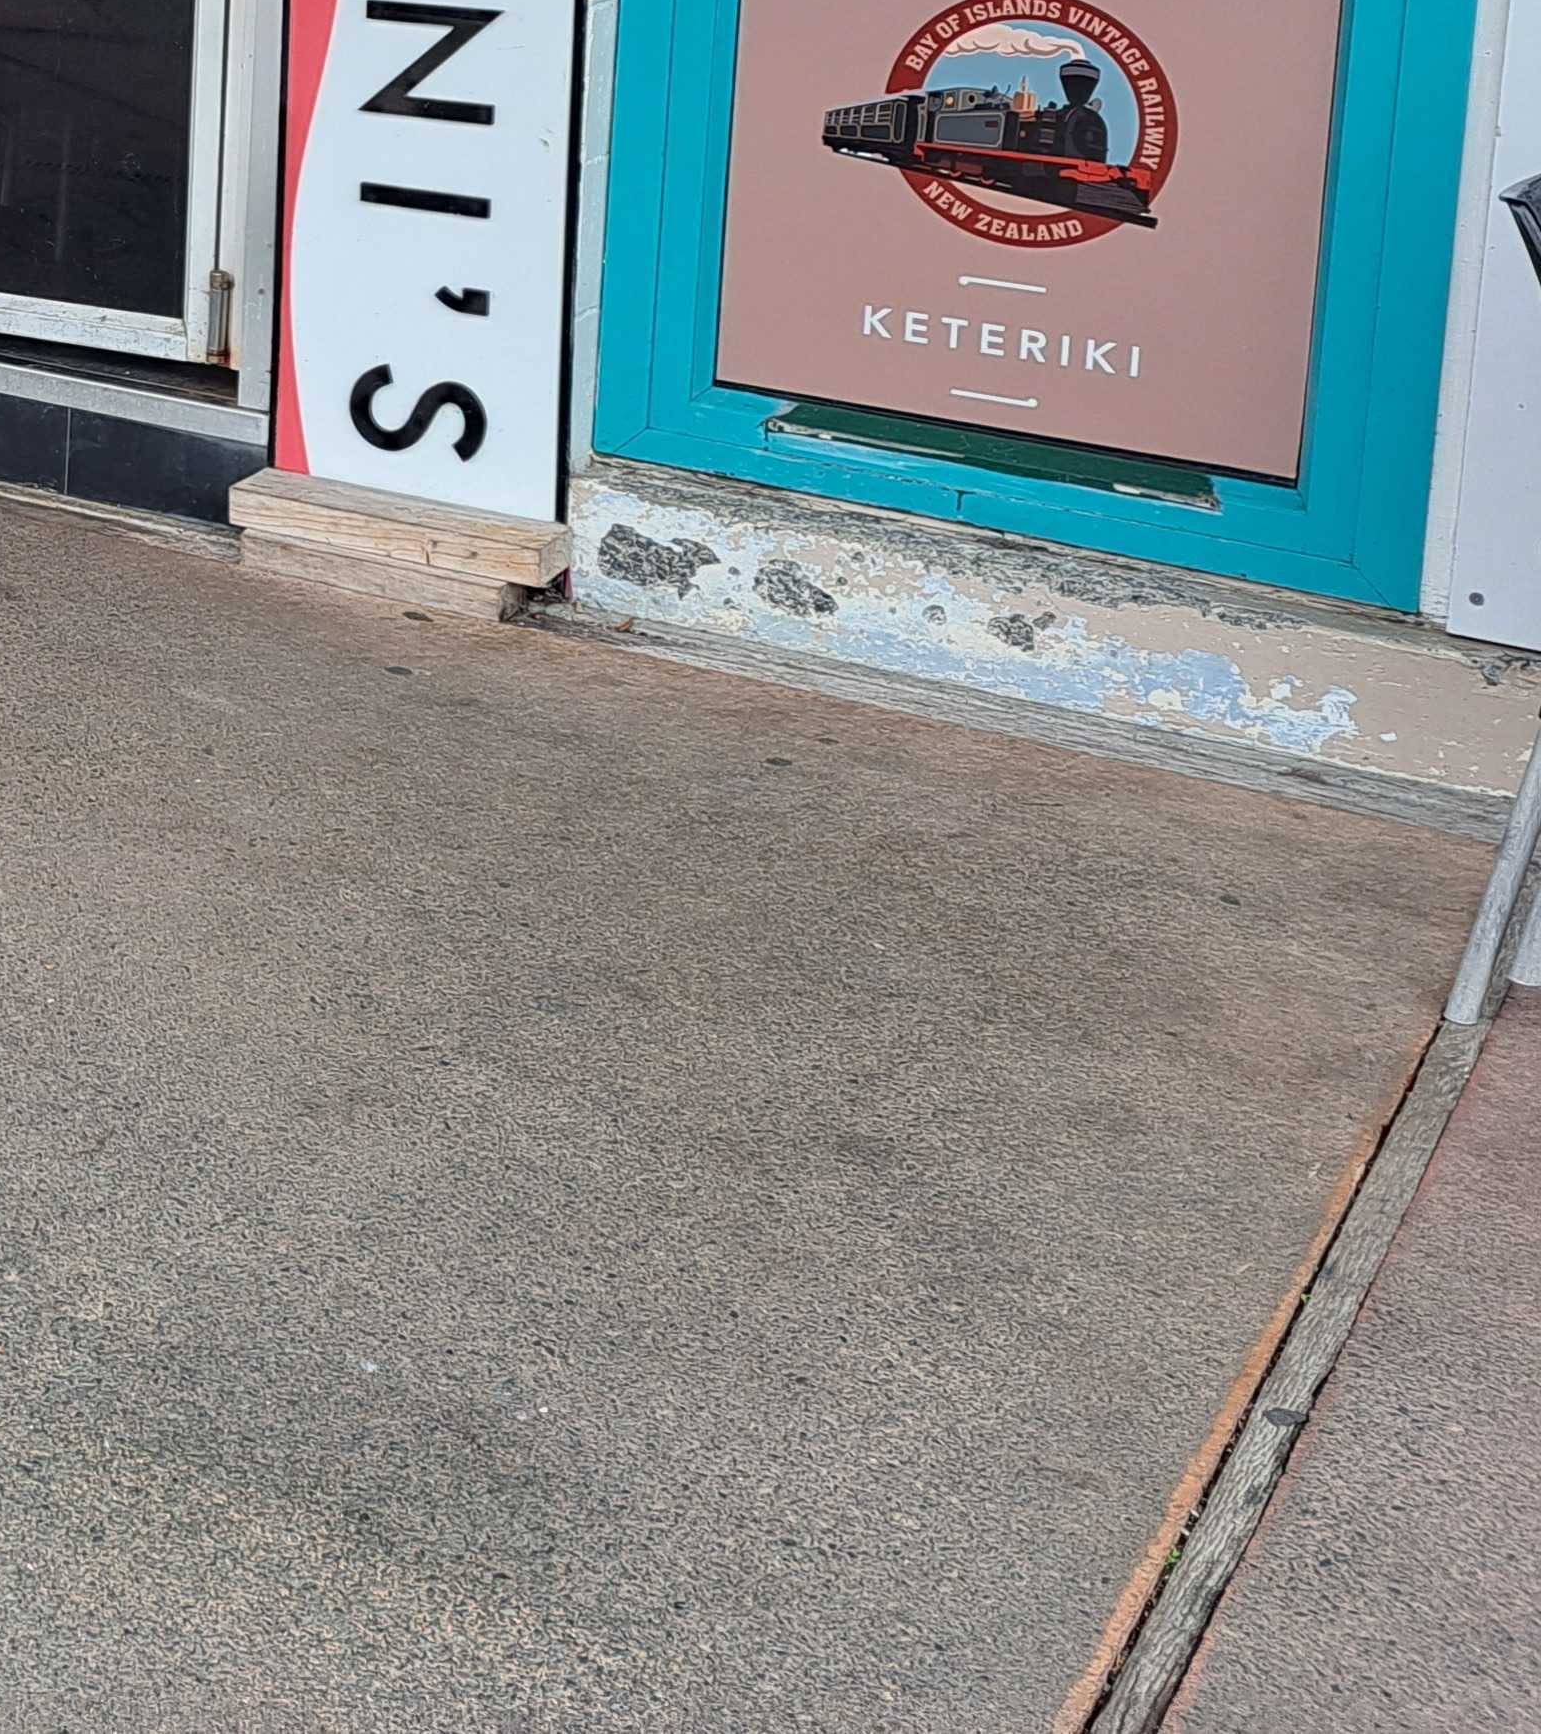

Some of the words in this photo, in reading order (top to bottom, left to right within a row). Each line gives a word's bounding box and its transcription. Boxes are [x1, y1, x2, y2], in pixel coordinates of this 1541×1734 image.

[903, 32, 936, 73] BAY
[937, 13, 963, 41] OF
[1066, 6, 1151, 77] VINTAGE
[1136, 77, 1167, 169] RAILWAY
[922, 179, 974, 222] NEW
[973, 215, 1085, 243] ZEALAND
[862, 302, 1143, 379] KETERIKI
